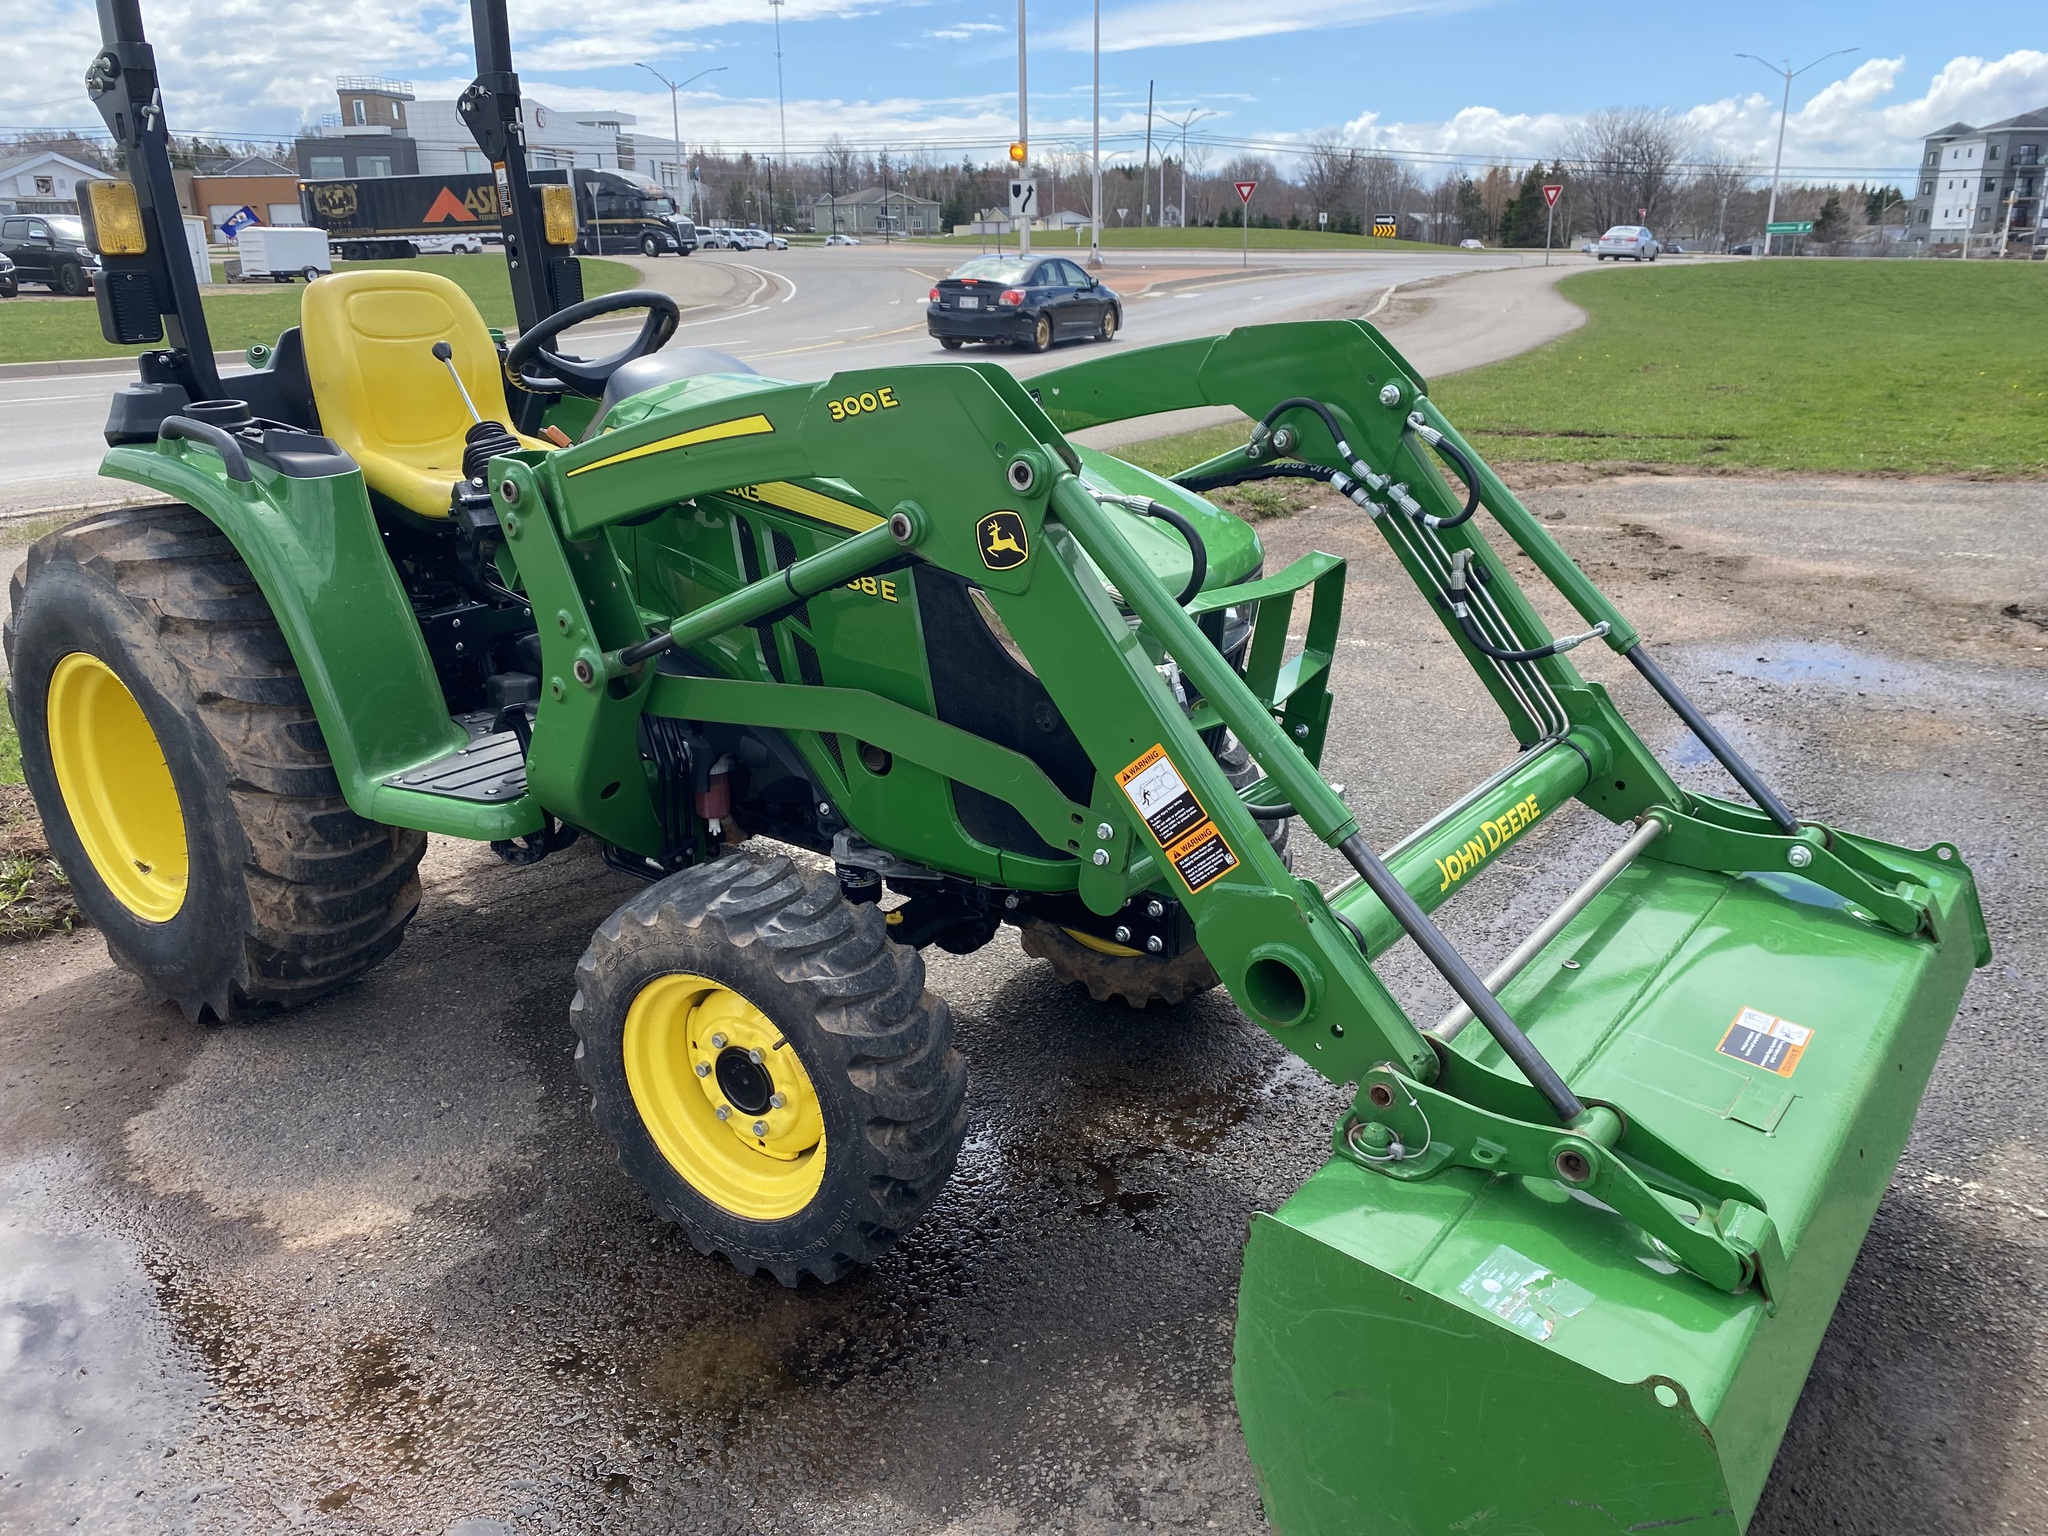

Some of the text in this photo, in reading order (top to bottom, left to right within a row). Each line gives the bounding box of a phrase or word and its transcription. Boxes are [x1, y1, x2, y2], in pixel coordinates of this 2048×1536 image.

[1128, 750, 1159, 776] WARNING
[1180, 828, 1212, 853] WARNING
[1435, 793, 1541, 893] JOHN DEERE
[604, 930, 718, 972] GALAXY
